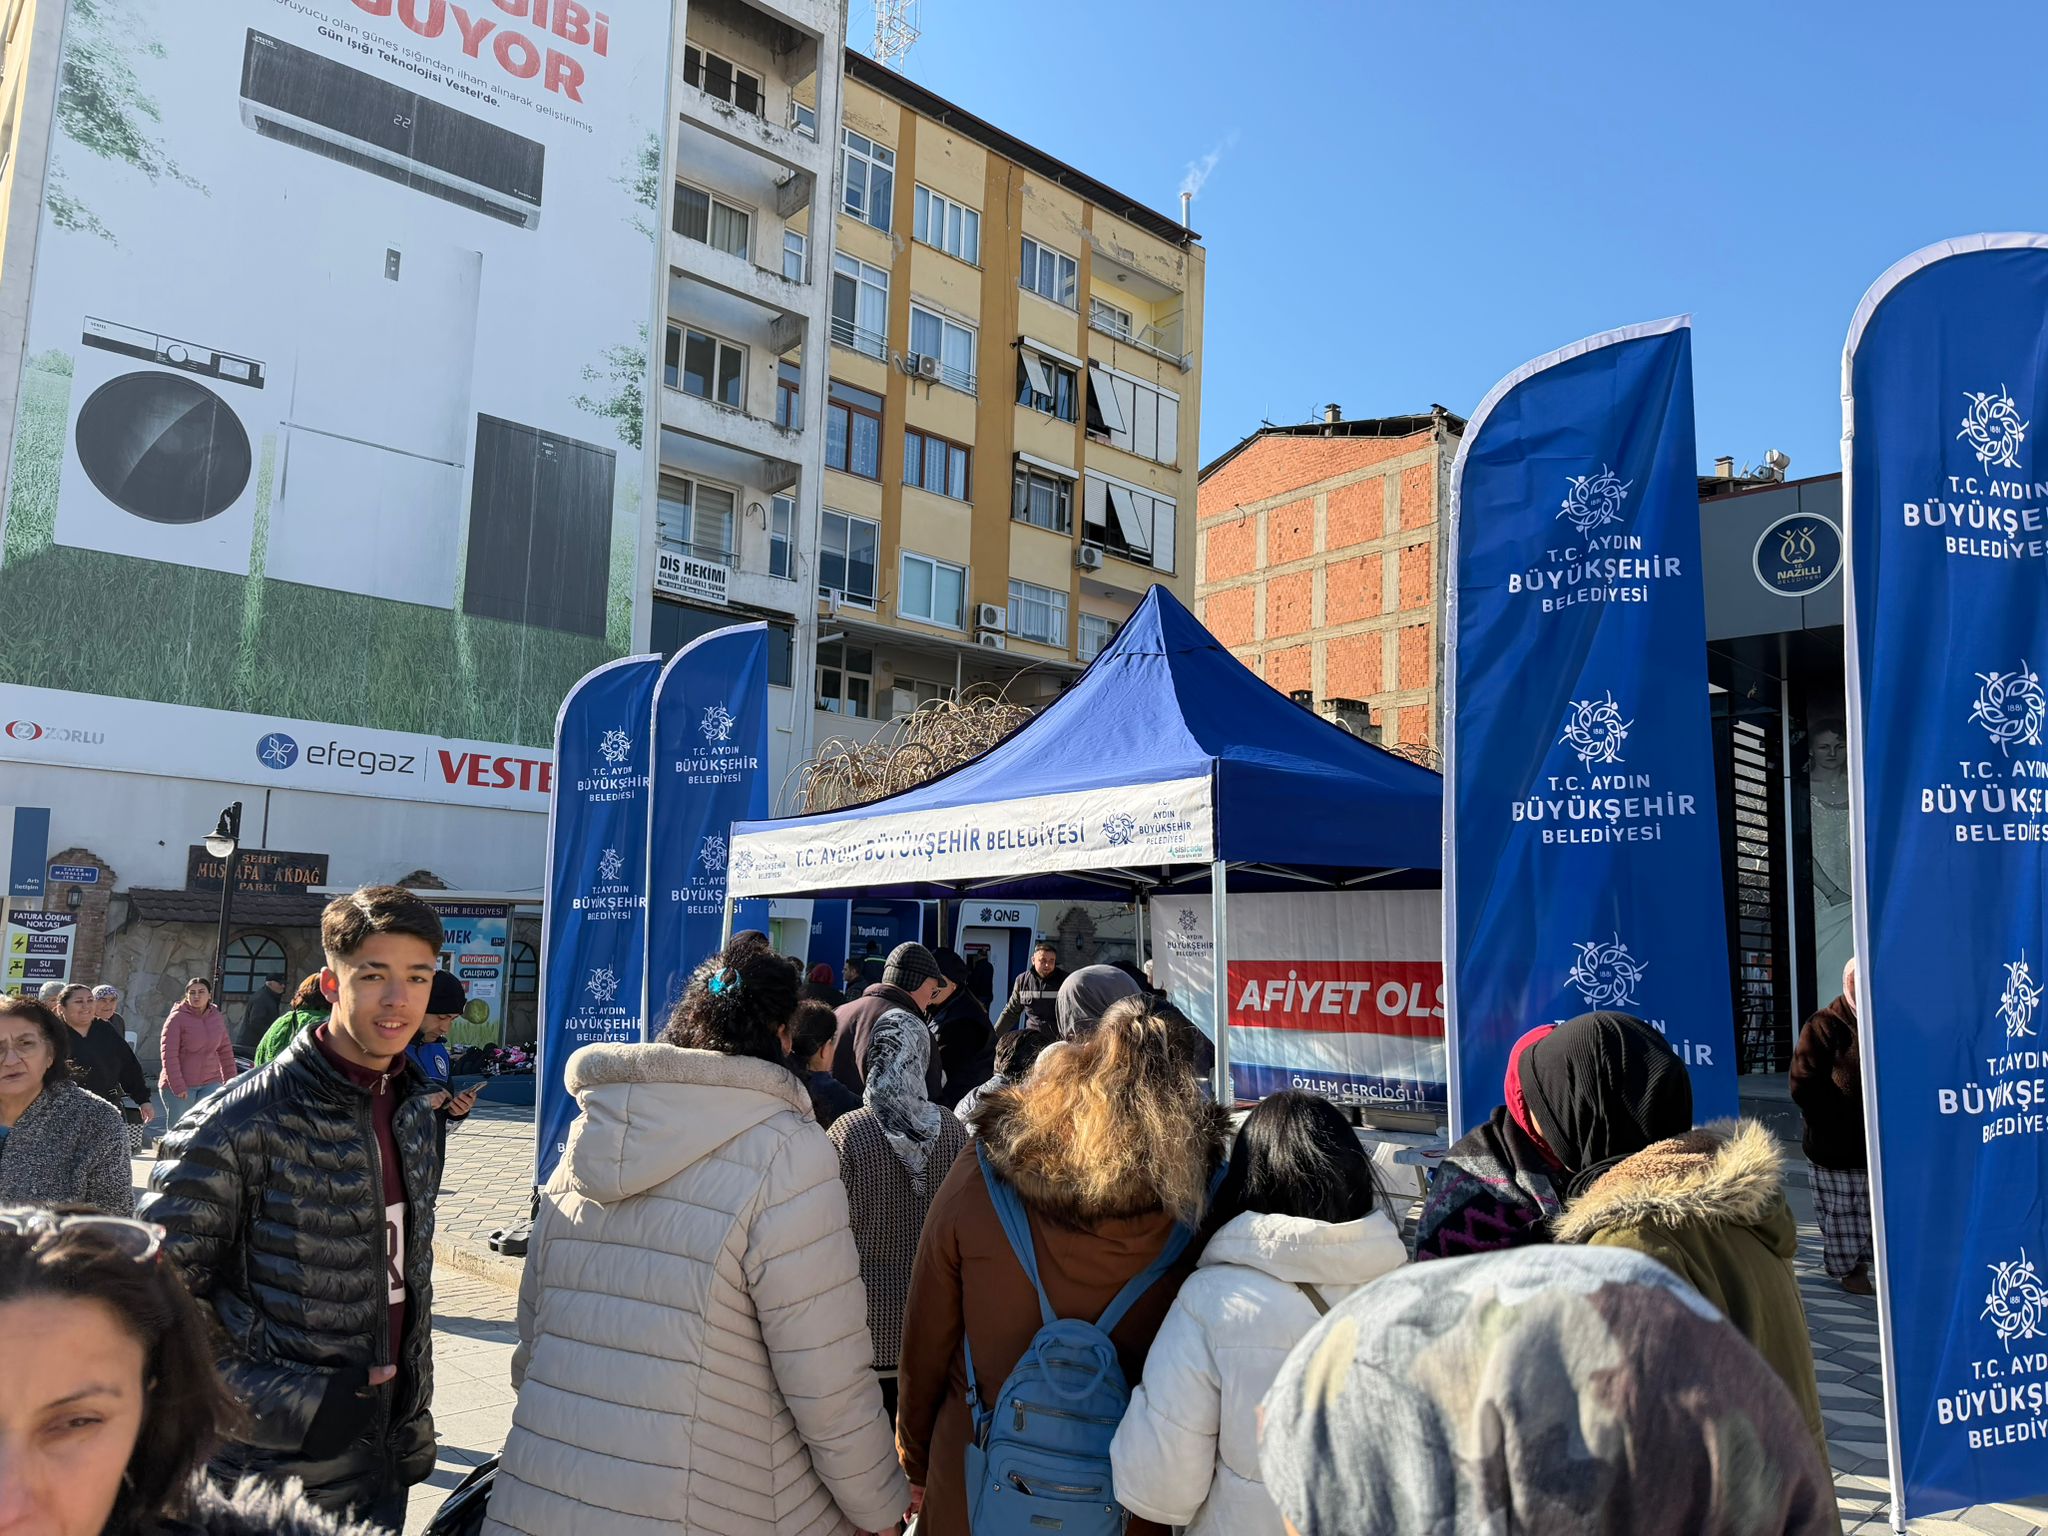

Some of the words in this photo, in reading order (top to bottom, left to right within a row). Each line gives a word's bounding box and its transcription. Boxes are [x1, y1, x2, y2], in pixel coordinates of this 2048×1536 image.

[317, 25, 343, 43] Gün
[347, 37, 373, 55] Işığı
[377, 48, 441, 83] Teknolojisi
[272, 0, 328, 22] ruyucu
[331, 18, 358, 34] olan
[362, 28, 399, 52] güneş
[457, 67, 487, 89] ilham
[490, 82, 533, 108] alınarak
[535, 103, 593, 133] geliştirilmiş
[393, 114, 411, 129] 22
[1948, 476, 1984, 495] T.C.
[1989, 479, 2048, 500] AYDIN
[1903, 498, 2048, 539] BÜYÜKŞE
[1547, 547, 1583, 563] T.C.
[1588, 535, 1642, 554] AYDIN
[1946, 536, 2048, 559] BELEDİYE
[660, 555, 679, 573] DİŞ
[684, 561, 725, 583] HEKİMİ
[1508, 555, 1682, 593] BÜYÜKŞEHİR
[1542, 584, 1648, 613] BELEDİYESİ
[2007, 704, 2023, 712] 1881
[44, 726, 104, 745] ZORLU
[307, 741, 415, 775] efegaz
[693, 747, 708, 756] T.C.
[711, 745, 739, 755] AYDIN
[593, 768, 609, 776] T.C.
[675, 757, 758, 773] BÜYÜKŞEHİR
[1959, 761, 2002, 778] T.C.
[2012, 760, 2048, 779] AYDN
[577, 775, 650, 792] BÜYÜKŞEHİR
[688, 772, 742, 784] BELEDİYESİ
[1548, 776, 1585, 791] T.C.
[1591, 774, 1650, 790] AYDIN
[1511, 791, 1697, 824] BÜYÜKŞEHİR
[1921, 783, 2048, 819] BÜYÜKŞE
[1153, 810, 1175, 819] AYDIN
[1139, 820, 1192, 835] BÜYÜKŞEHİR
[1542, 823, 1661, 844] BELEDİYESİ
[796, 848, 817, 867] T.C.
[865, 823, 980, 861] BÜYÜKŞEHİR
[987, 817, 1086, 851] BELEDİYESİ
[1146, 834, 1186, 845] BELEDİYESİ
[241, 854, 280, 864] ŞEHİT
[197, 862, 260, 880] MUSAFA
[274, 866, 320, 884] AKDAĞ
[601, 885, 629, 894] AYDIN
[692, 877, 707, 886] T.C.
[671, 887, 759, 904] BÜYÜKŞ
[13, 912, 42, 920] FATURA
[44, 912, 72, 921] ÖDEME
[431, 905, 459, 914] ŞEHİR
[462, 906, 503, 916] BELEDİYESİ
[688, 904, 742, 914] BELEDİYSİ
[993, 909, 1020, 922] QNB
[26, 920, 60, 928] NOKTASI
[857, 925, 889, 937] YapıKredi
[29, 935, 67, 944] ELEKTRİK
[1167, 940, 1214, 951] BÜYÜKŞEHİR
[39, 960, 51, 968] SU
[461, 955, 499, 964] BÜYÜKŞEHİR
[463, 970, 495, 978] ÇALIŞIYOR
[1236, 969, 1371, 1015] AFİYET
[580, 1007, 597, 1015] T.C.
[599, 1006, 626, 1015] AYDIN
[576, 1032, 629, 1041] BELEDİYESİ
[1292, 1074, 1338, 1094] ÖZLEM
[1982, 1113, 2048, 1143] BELEDİYE
[1971, 1359, 2005, 1380] T.C.
[1937, 1381, 2048, 1425] BÜYÜKŞ
